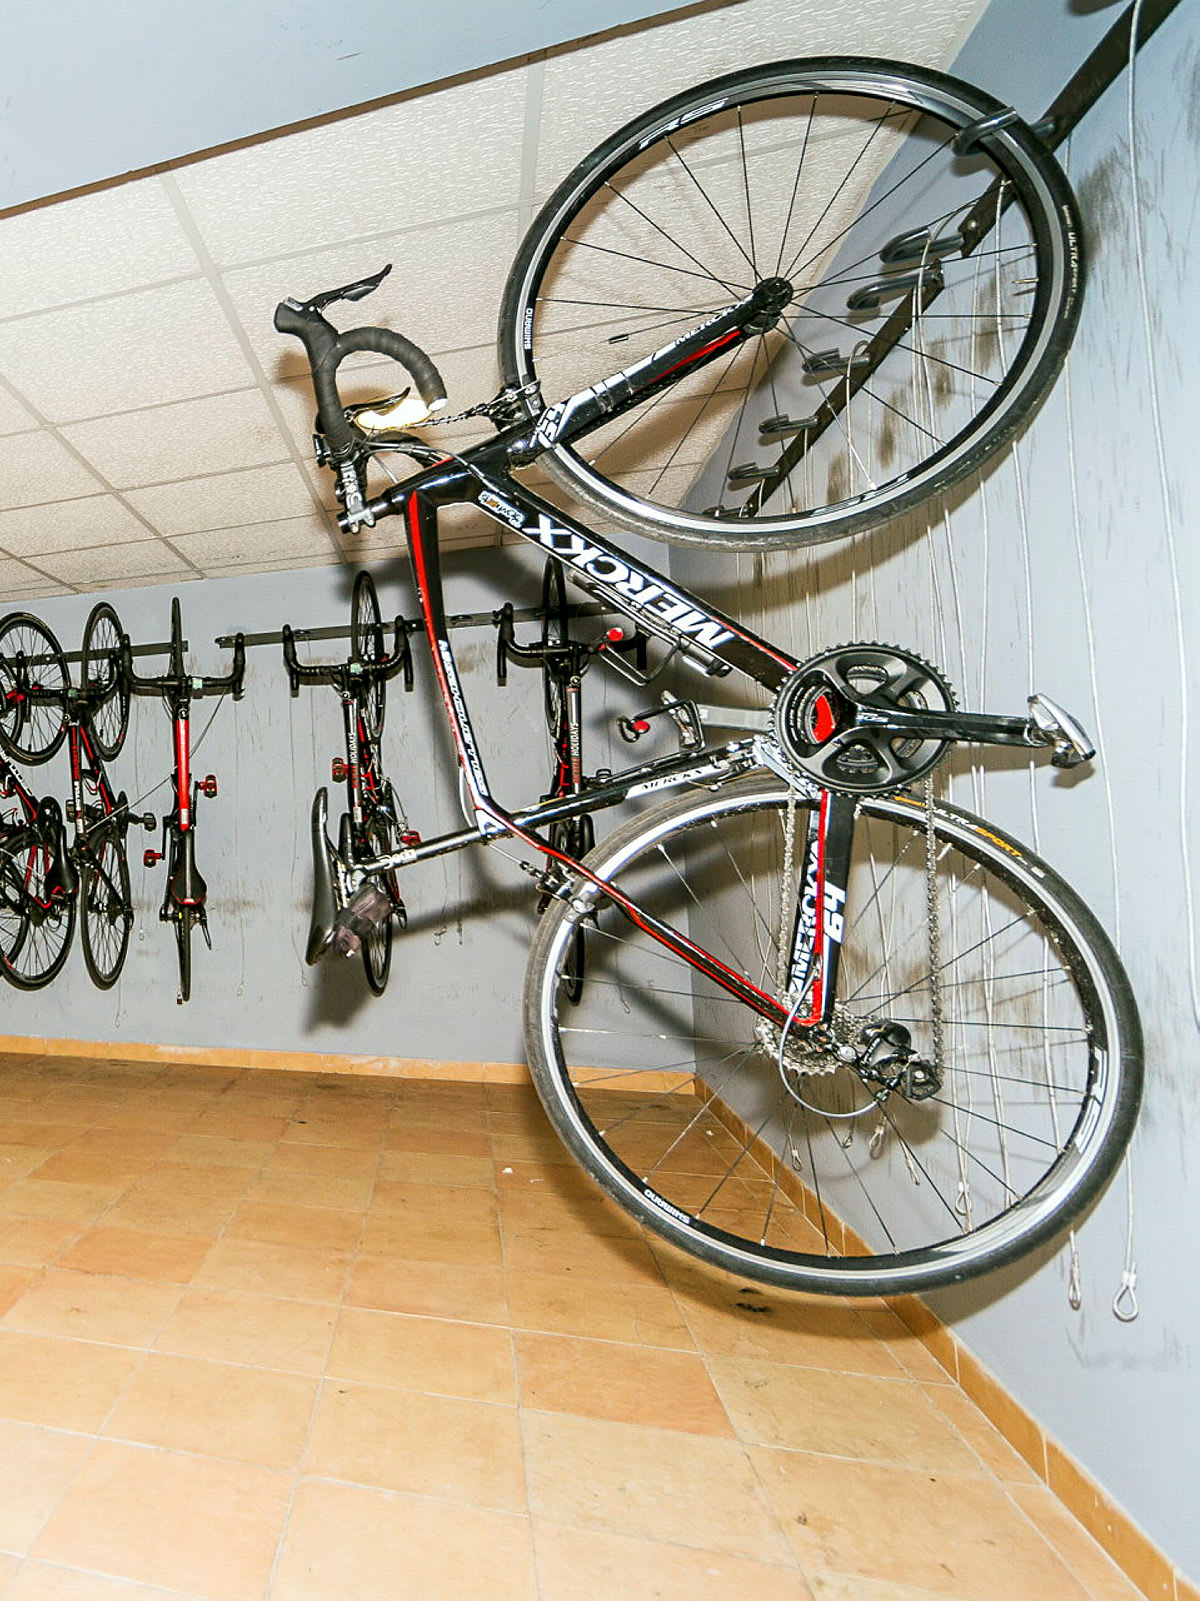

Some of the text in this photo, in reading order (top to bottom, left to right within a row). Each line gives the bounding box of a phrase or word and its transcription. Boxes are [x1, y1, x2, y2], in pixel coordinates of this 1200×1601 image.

[523, 308, 534, 350] SHIMANO
[522, 513, 735, 649] MERCKX
[570, 722, 580, 755] HOLIDAYS
[643, 1188, 691, 1225] SHIMANO
